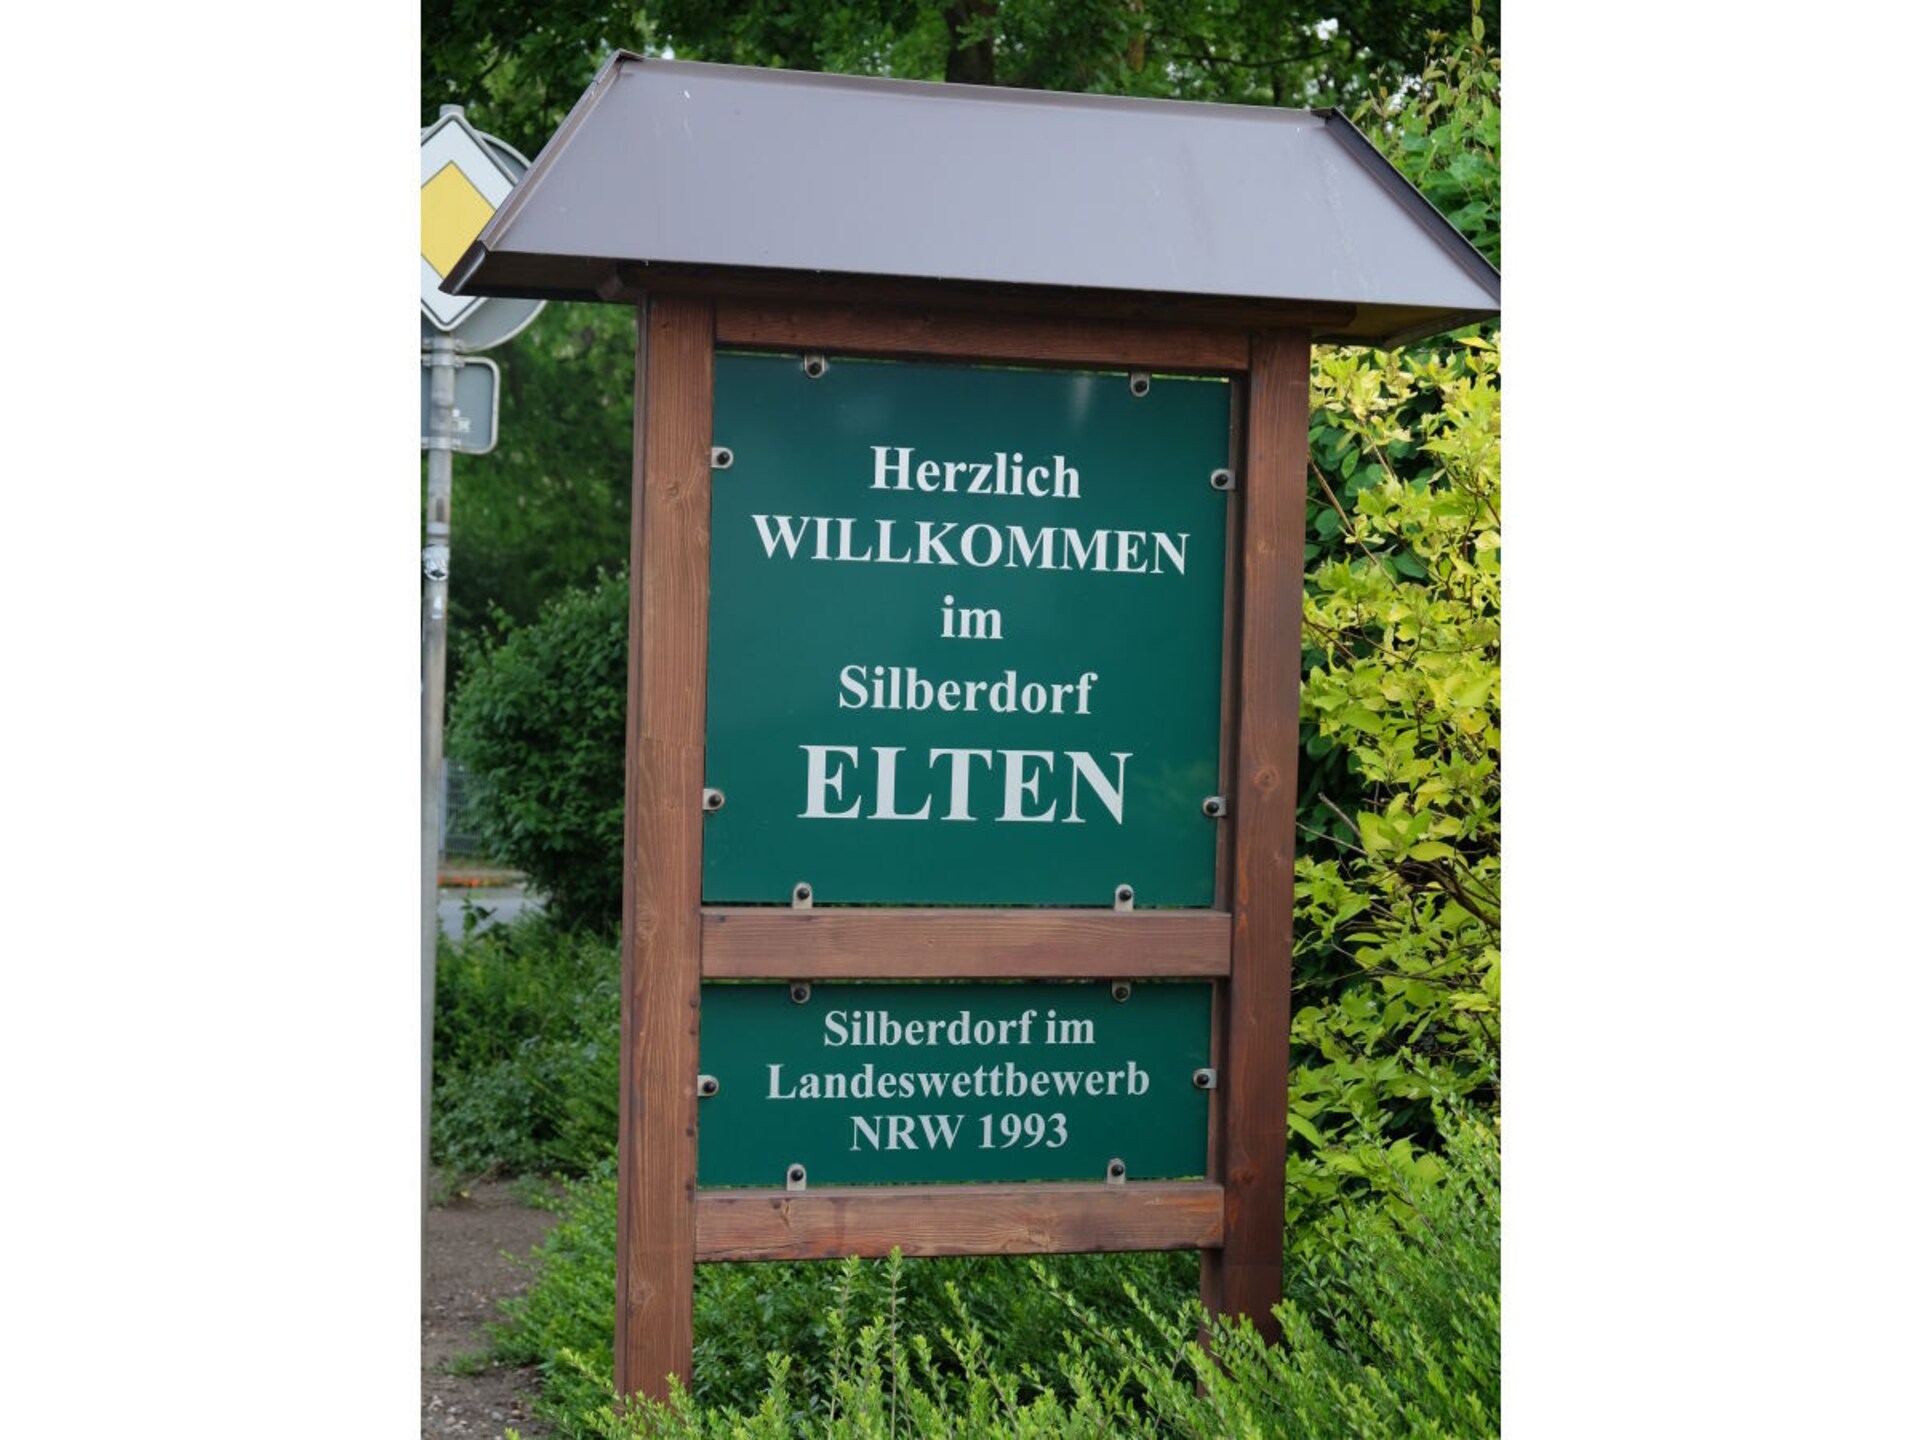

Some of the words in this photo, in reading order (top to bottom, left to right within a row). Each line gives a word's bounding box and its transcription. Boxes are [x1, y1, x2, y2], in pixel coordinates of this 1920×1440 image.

[870, 445, 1081, 499] Herzlich
[751, 514, 1190, 575] WILLKOMMEN
[941, 594, 1003, 640] im
[839, 664, 1098, 714] Silberdorf
[798, 745, 1133, 825] ELTEN
[824, 1009, 1038, 1046] Silberdorf
[1046, 1009, 1095, 1044] im
[768, 1061, 1150, 1099] Landeswettbewerb
[851, 1114, 964, 1150] NRW
[980, 1113, 1068, 1148] 1993
